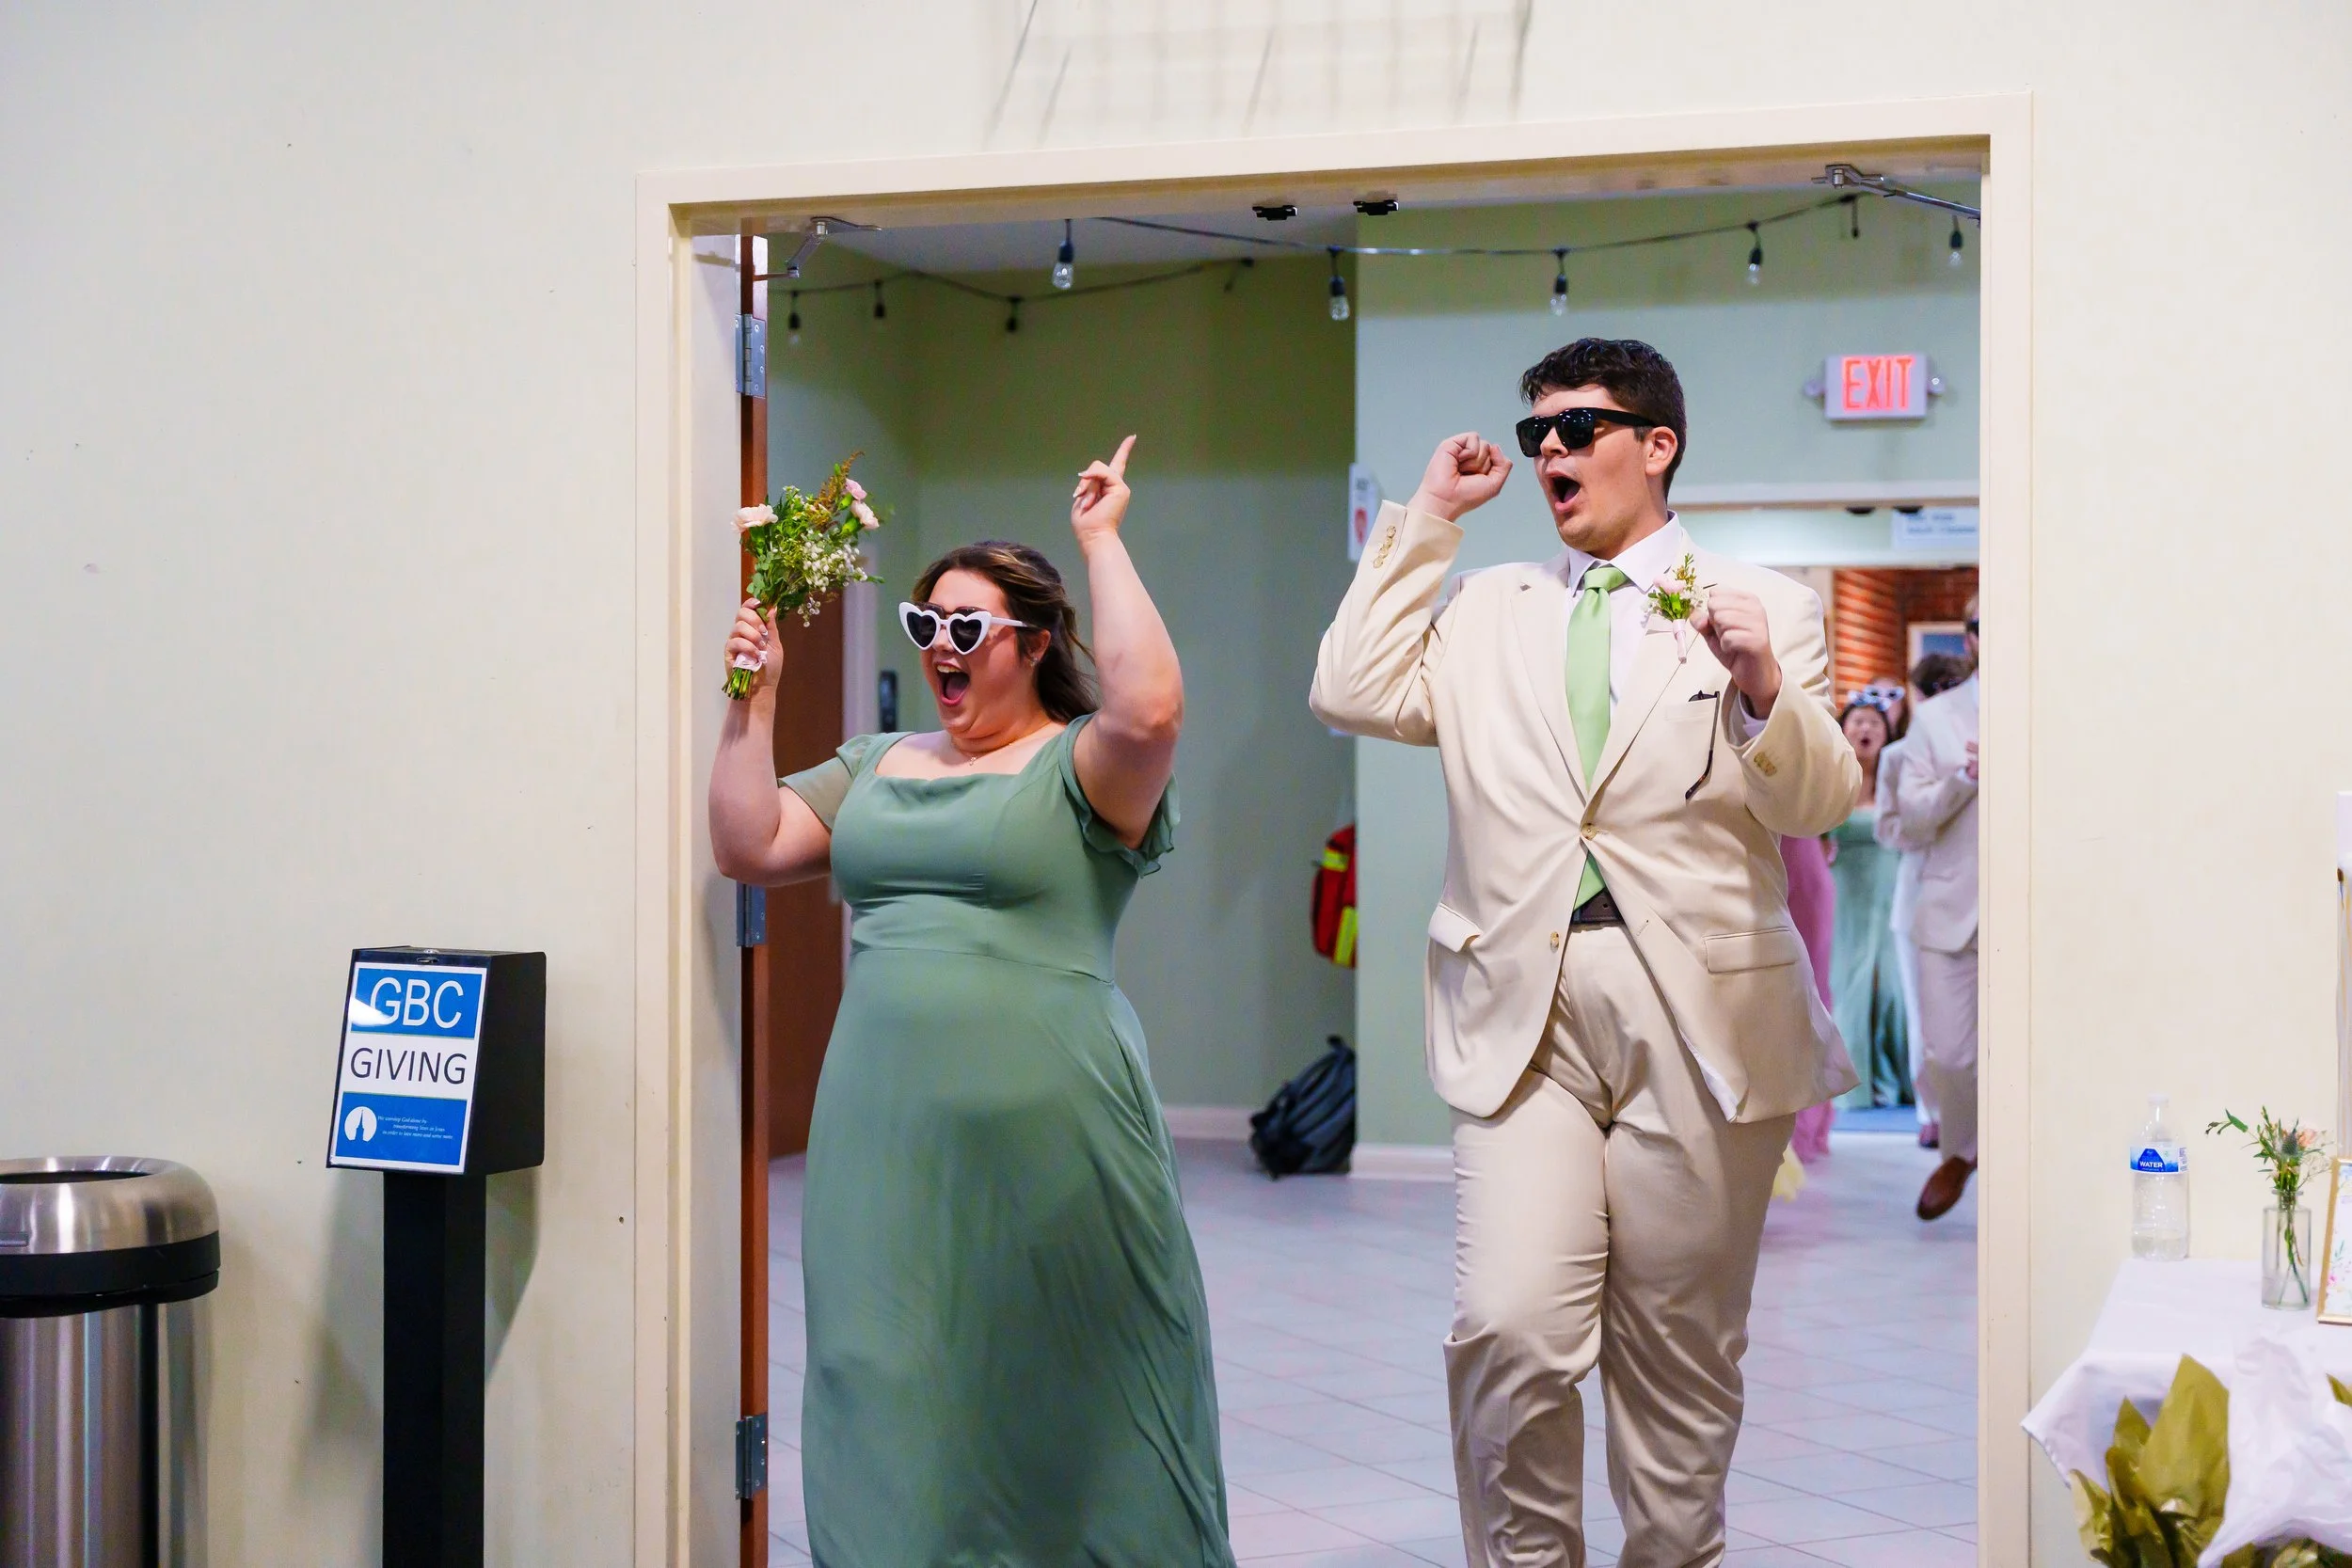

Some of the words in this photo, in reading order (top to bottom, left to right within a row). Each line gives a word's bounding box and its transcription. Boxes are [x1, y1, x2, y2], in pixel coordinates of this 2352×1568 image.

[1844, 356, 1913, 409] EXIT
[371, 977, 464, 1029] GBC
[350, 1048, 468, 1085] GIVING
